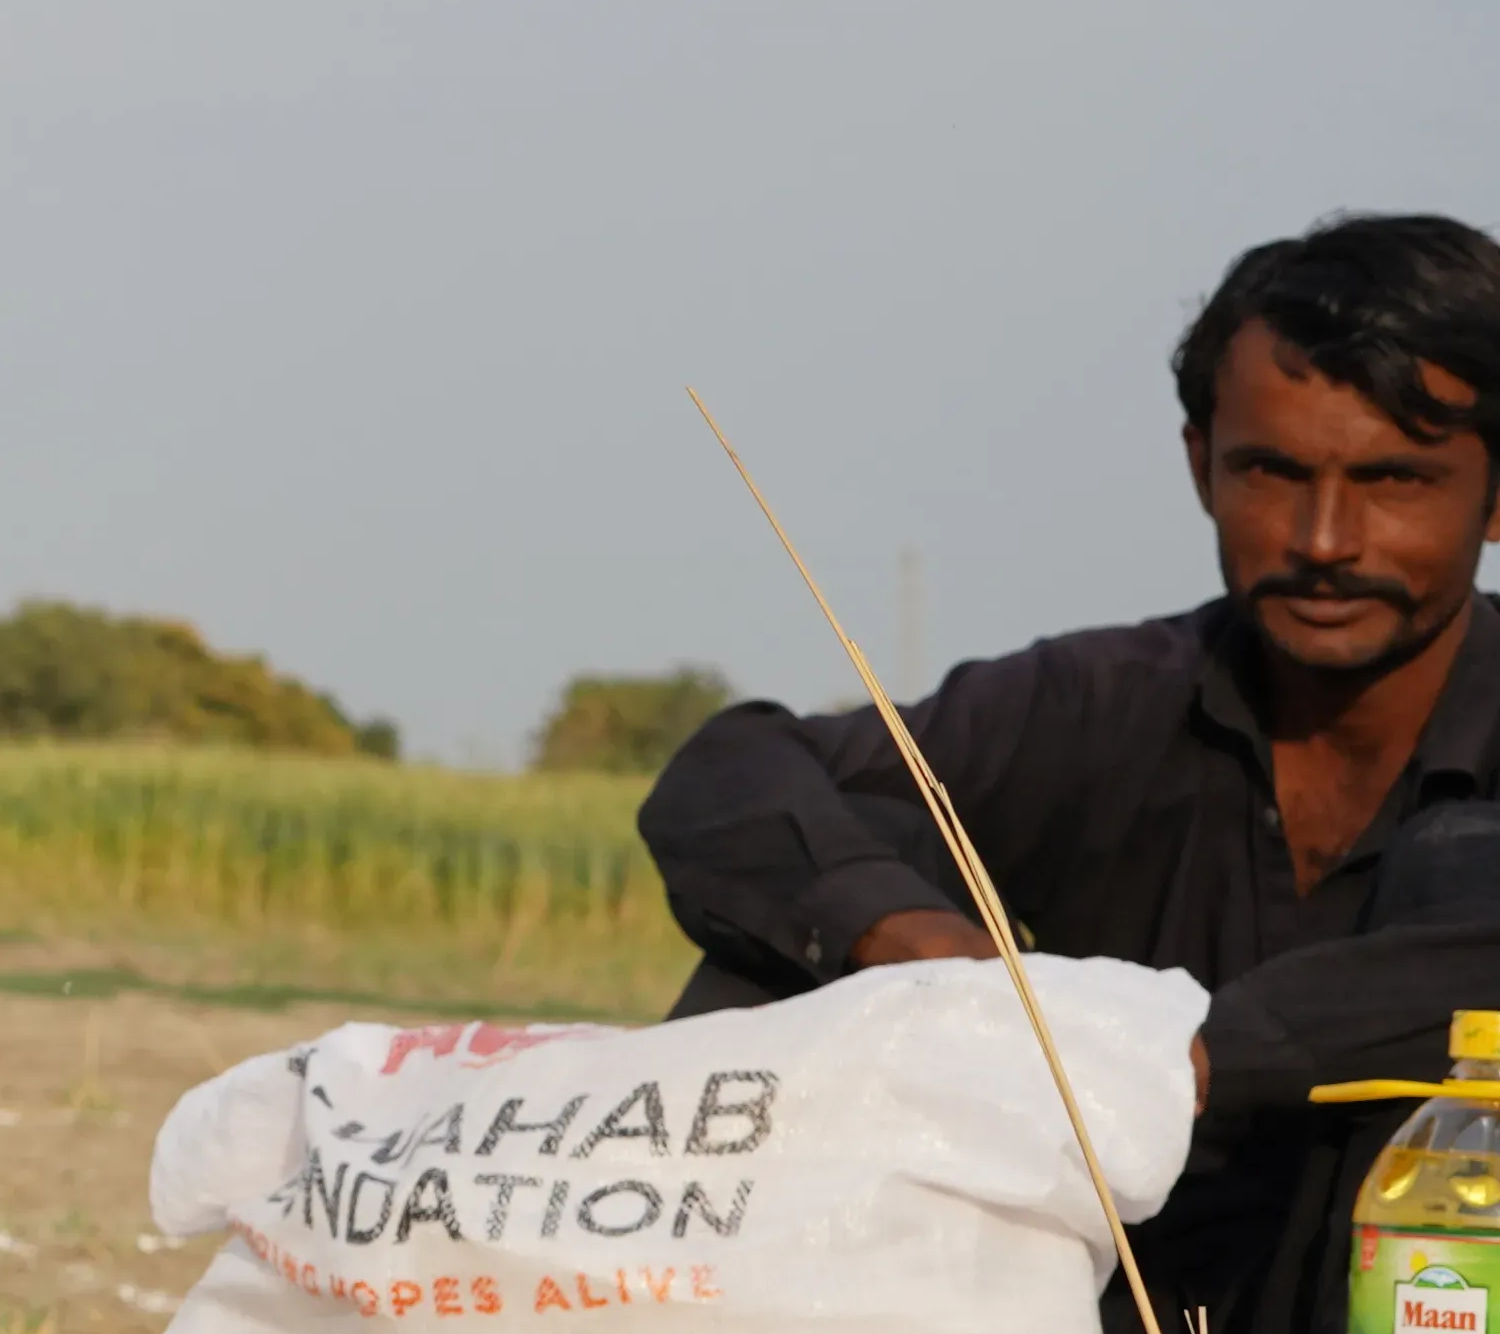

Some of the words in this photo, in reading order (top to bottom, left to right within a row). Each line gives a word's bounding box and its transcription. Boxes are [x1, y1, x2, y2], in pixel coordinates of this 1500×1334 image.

[266, 1148, 754, 1246] NDATION
[533, 1264, 724, 1316] ALIVE
[1402, 1300, 1477, 1332] Maan
